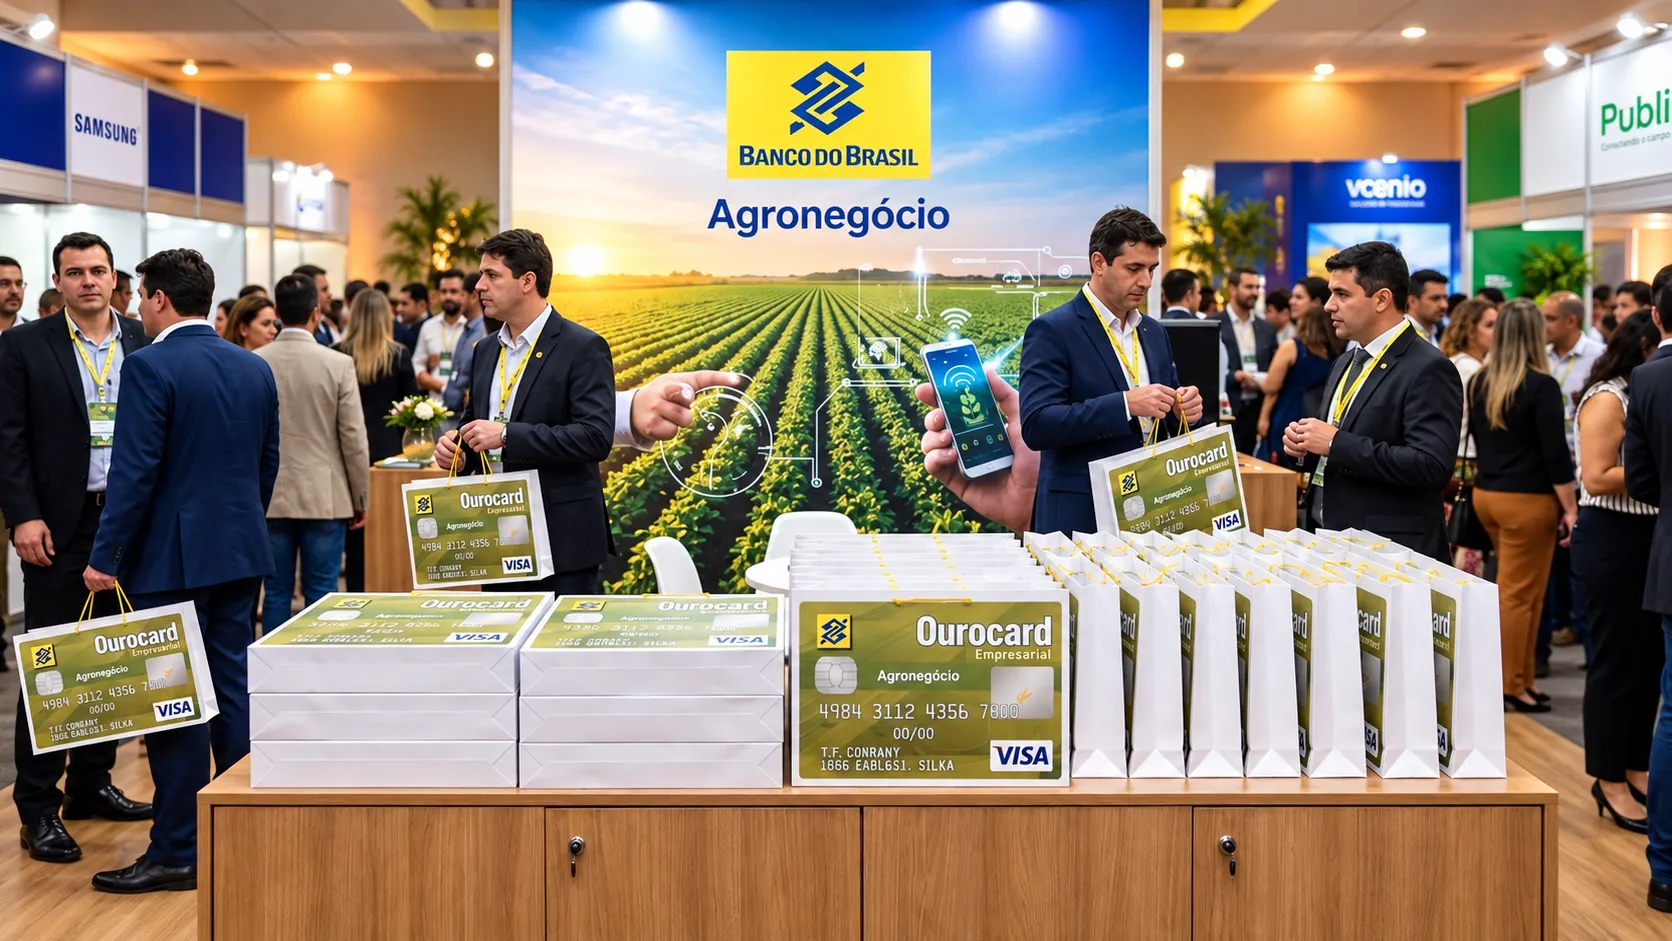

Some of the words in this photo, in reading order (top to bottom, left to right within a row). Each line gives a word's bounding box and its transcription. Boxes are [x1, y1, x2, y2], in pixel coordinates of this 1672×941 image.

[1601, 88, 1670, 136] Publi
[75, 113, 137, 146] SAMSUNG
[815, 149, 842, 166] DO
[1345, 174, 1427, 199] vcenio
[707, 197, 950, 238] Agronegócio
[1166, 440, 1228, 477] Ourocard
[460, 487, 523, 509] Ourocard
[1214, 513, 1240, 530] VISA
[504, 558, 531, 571] VISA
[420, 598, 532, 609] Ourocard
[657, 600, 768, 611] Ourocard
[94, 621, 179, 654] Ourocard
[454, 633, 501, 641] VISA
[916, 615, 1053, 647] Ourocard
[975, 649, 1051, 662] Empresarial
[76, 665, 129, 682] Agronegócio
[877, 669, 960, 684] Agronegócio
[42, 696, 70, 711] 4984
[77, 690, 103, 705] 3112
[109, 684, 136, 697] 4356
[89, 702, 115, 715] 00/00
[155, 700, 192, 717] VISA
[819, 703, 862, 720] 4984
[872, 703, 915, 720] 3112
[925, 703, 969, 720] 4356
[980, 703, 1020, 720] 7800
[893, 727, 935, 742] 00/00
[821, 746, 842, 758] T.F.
[847, 746, 900, 758] CONRANY
[992, 745, 1049, 765] VISA
[918, 760, 955, 771] SILKA
